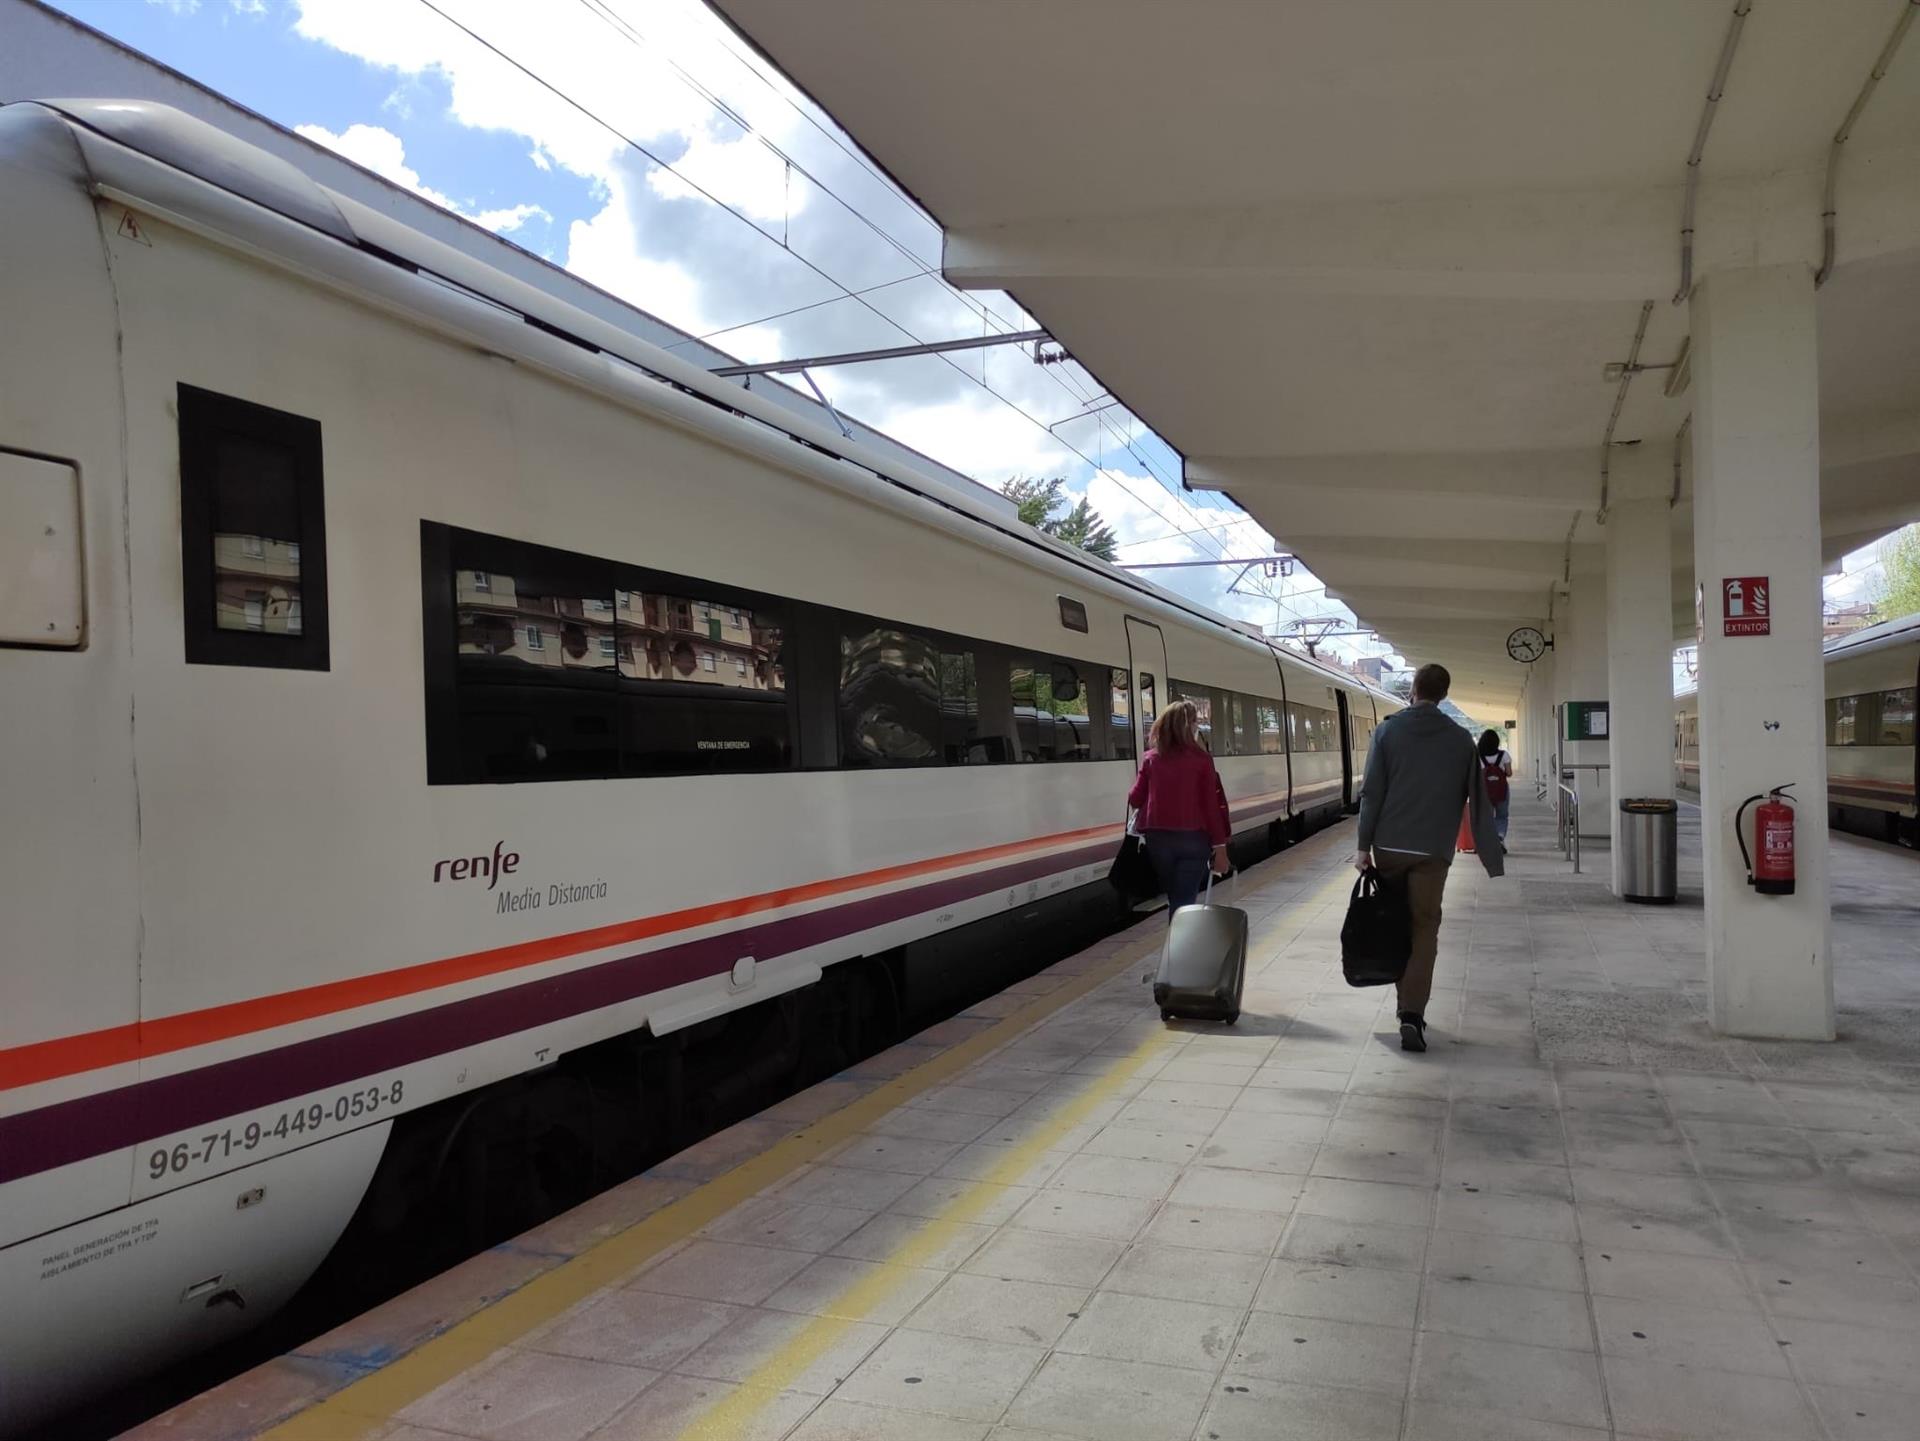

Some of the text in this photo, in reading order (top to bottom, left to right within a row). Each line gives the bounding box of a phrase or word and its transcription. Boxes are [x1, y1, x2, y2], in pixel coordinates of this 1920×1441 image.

[1725, 623, 1769, 632] EXTINTOR
[433, 840, 520, 891] renfe
[496, 877, 608, 914] Media Distancia
[150, 1079, 404, 1180] 96-71-9-449-053-8
[40, 1252, 102, 1280] AISLAMIENTO
[103, 1246, 115, 1258] DE
[134, 1236, 140, 1246] Y
[42, 1251, 70, 1266] PANEL
[131, 1223, 143, 1234] DE
